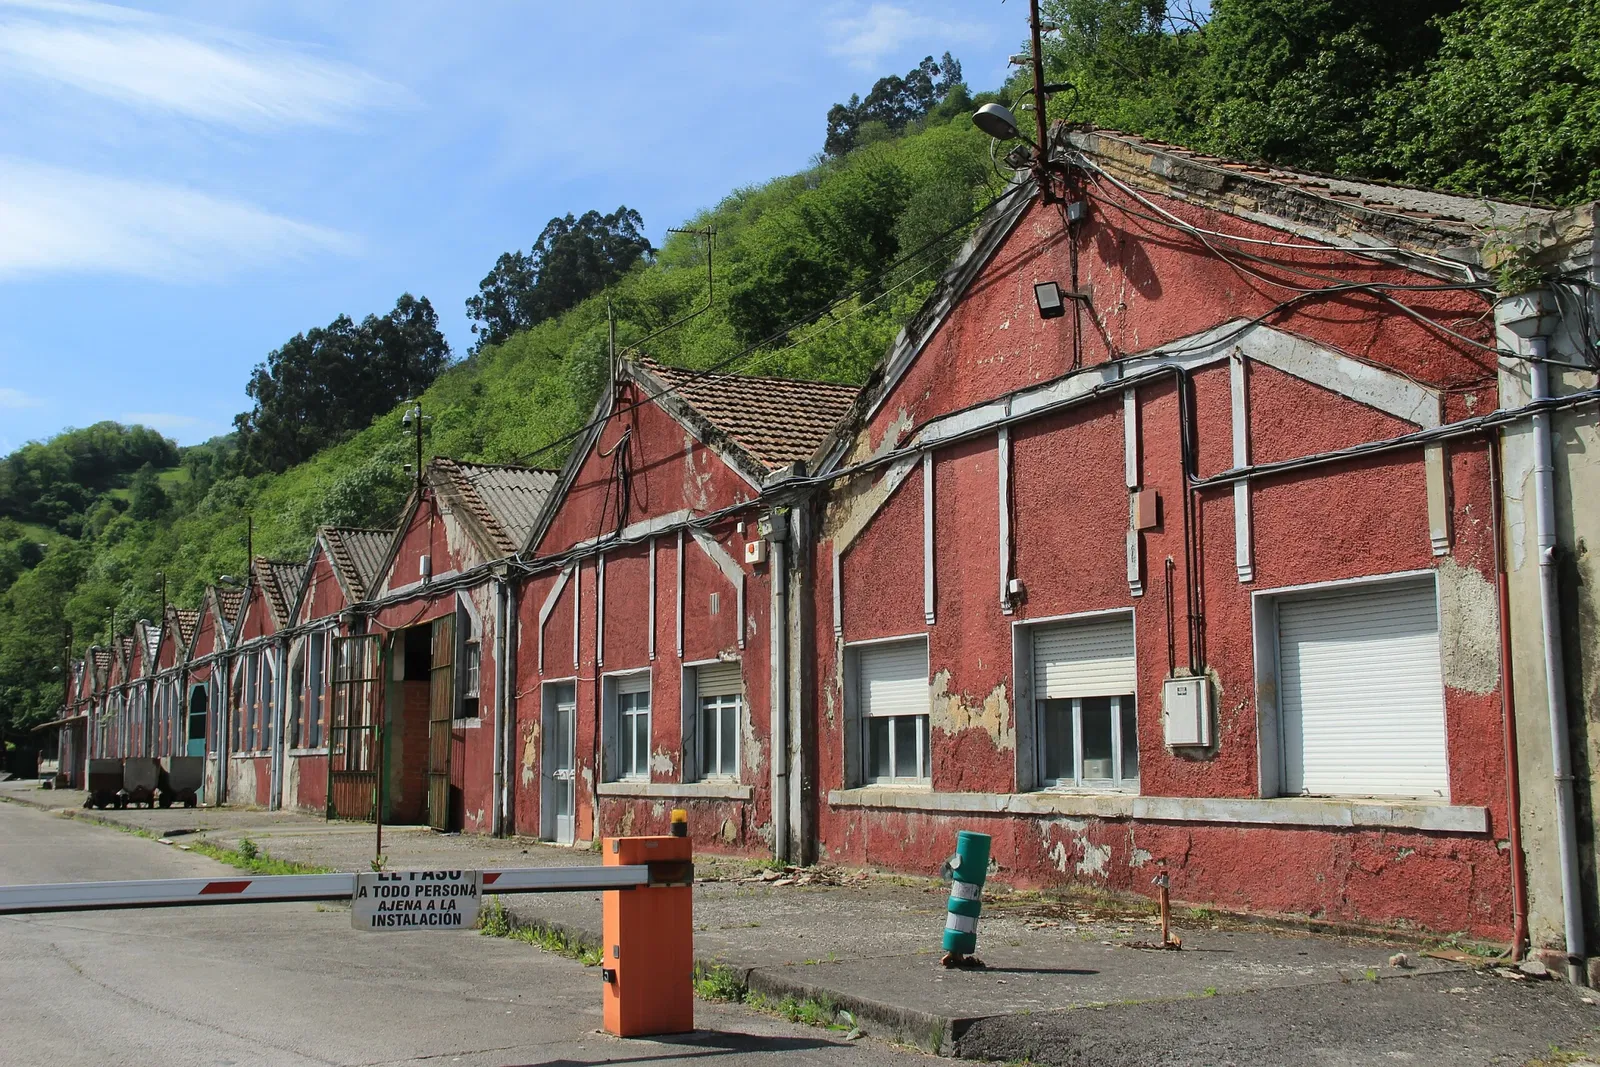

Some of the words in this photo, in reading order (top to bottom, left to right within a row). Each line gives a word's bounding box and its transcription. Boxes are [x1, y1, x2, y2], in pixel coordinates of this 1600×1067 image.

[358, 886, 368, 898] A
[372, 885, 410, 898] TODO
[415, 884, 477, 897] PERSONA
[378, 900, 422, 911] AJENA
[426, 899, 435, 910] A
[440, 899, 456, 910] LA
[372, 910, 462, 927] INSTALACIÓN
